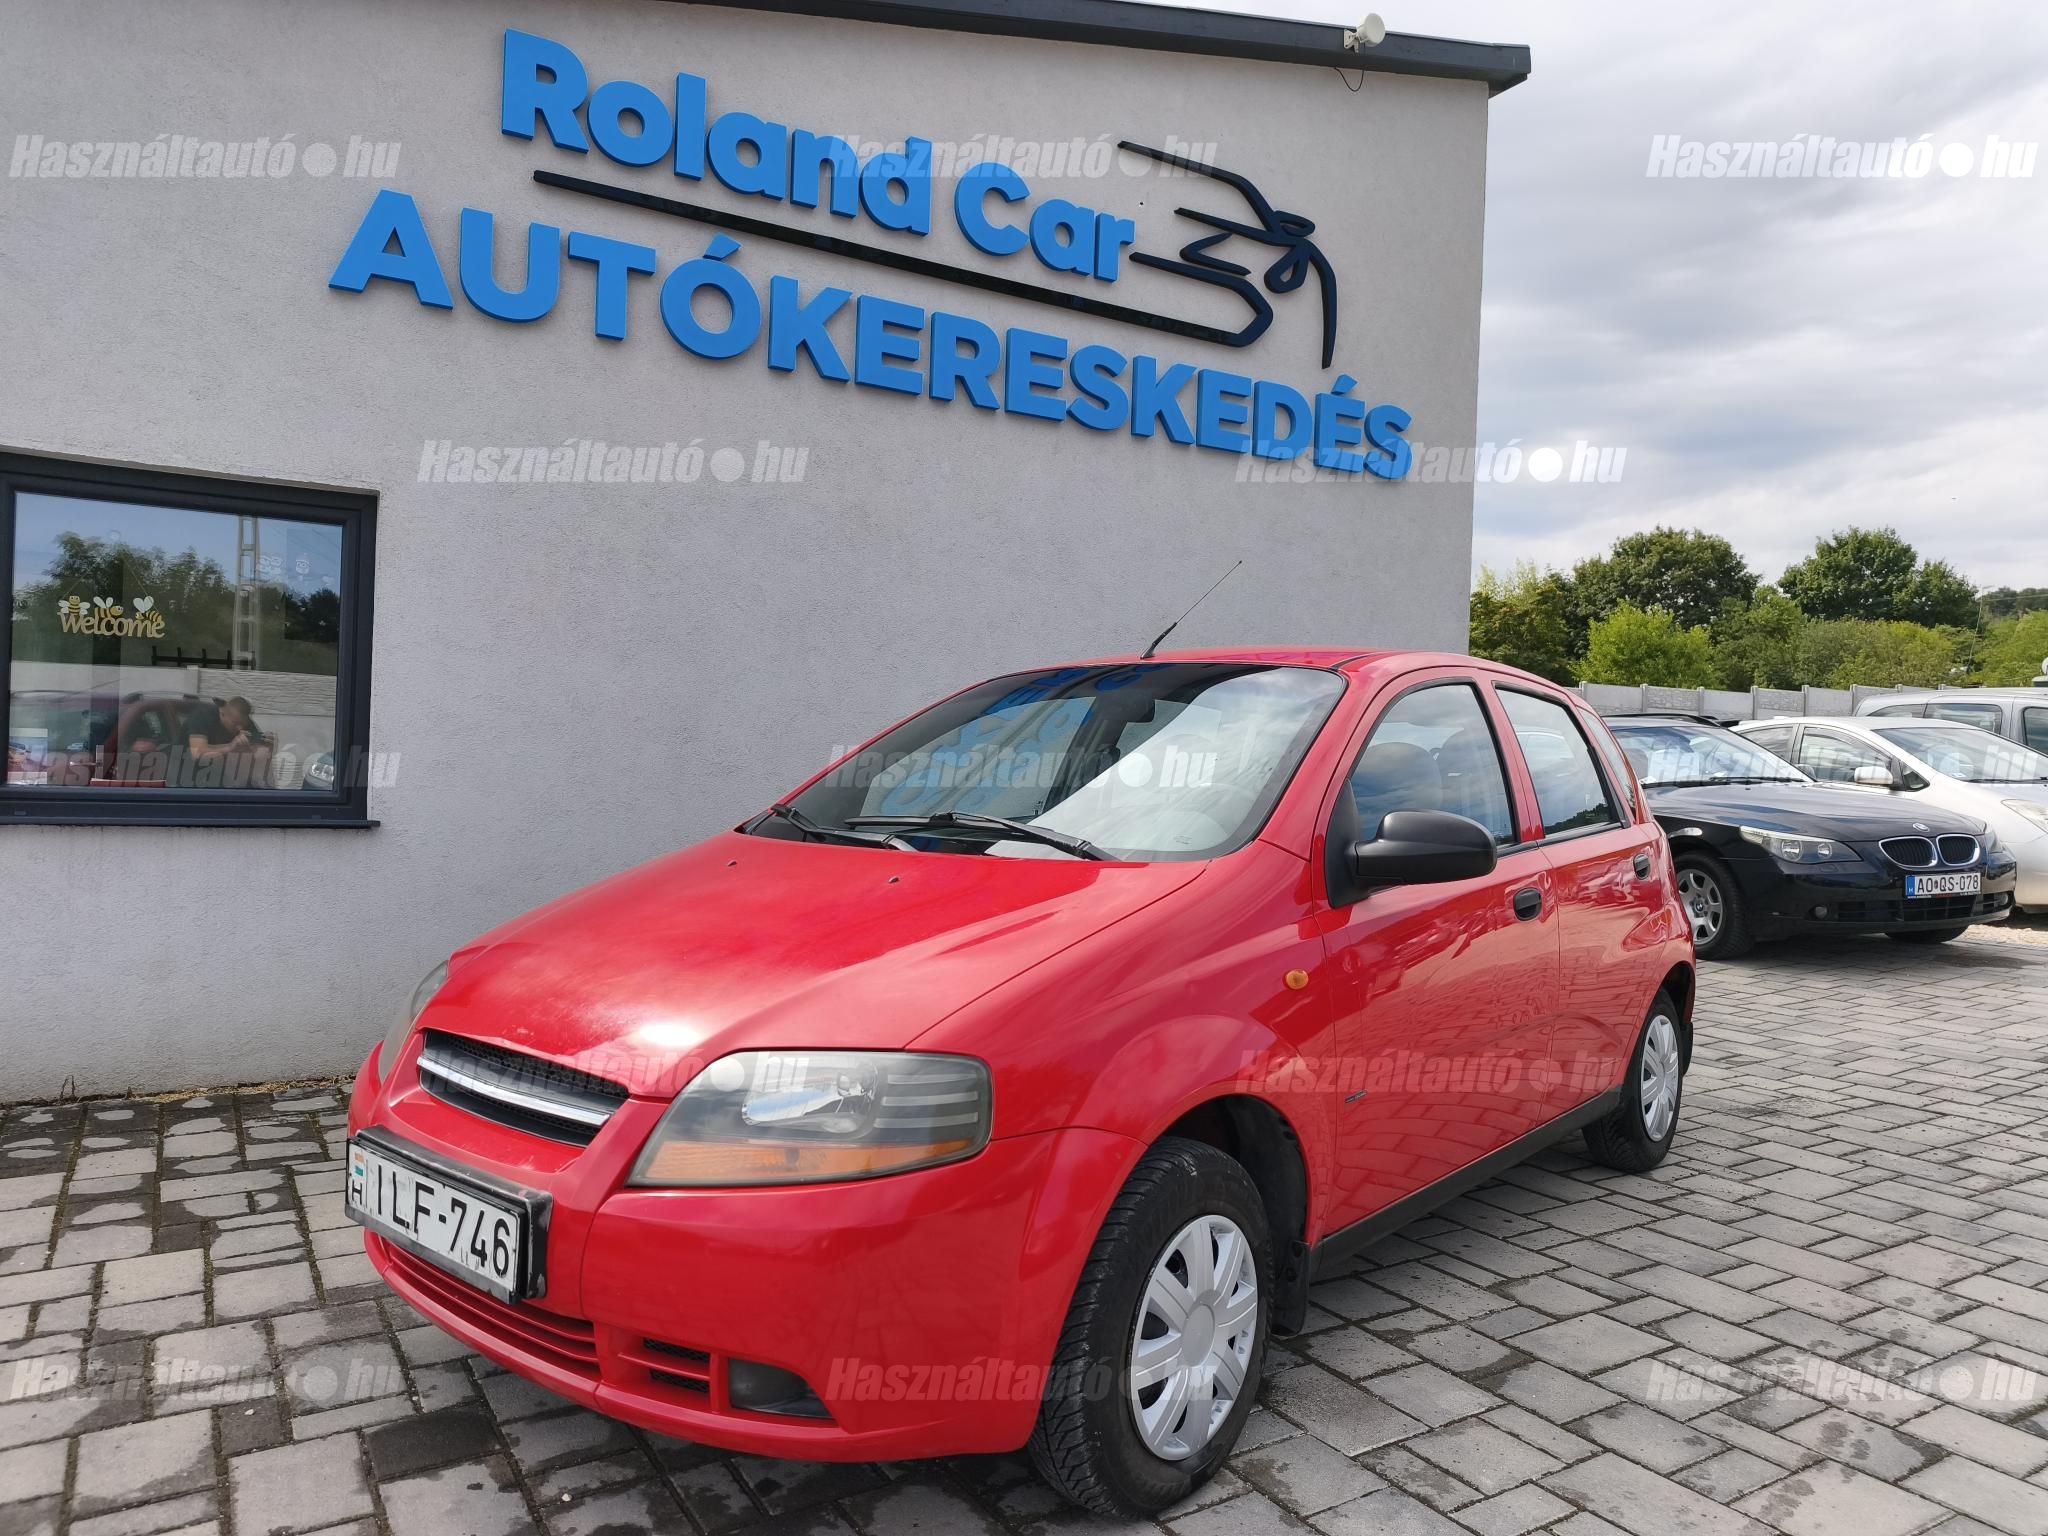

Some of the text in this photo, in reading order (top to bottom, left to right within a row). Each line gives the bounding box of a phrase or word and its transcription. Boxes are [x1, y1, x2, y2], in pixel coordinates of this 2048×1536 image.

[502, 28, 1134, 282] Roland Car
[329, 189, 1413, 481] AUTÓKERESKEDÉS
[351, 1164, 511, 1279] H ILF-746
